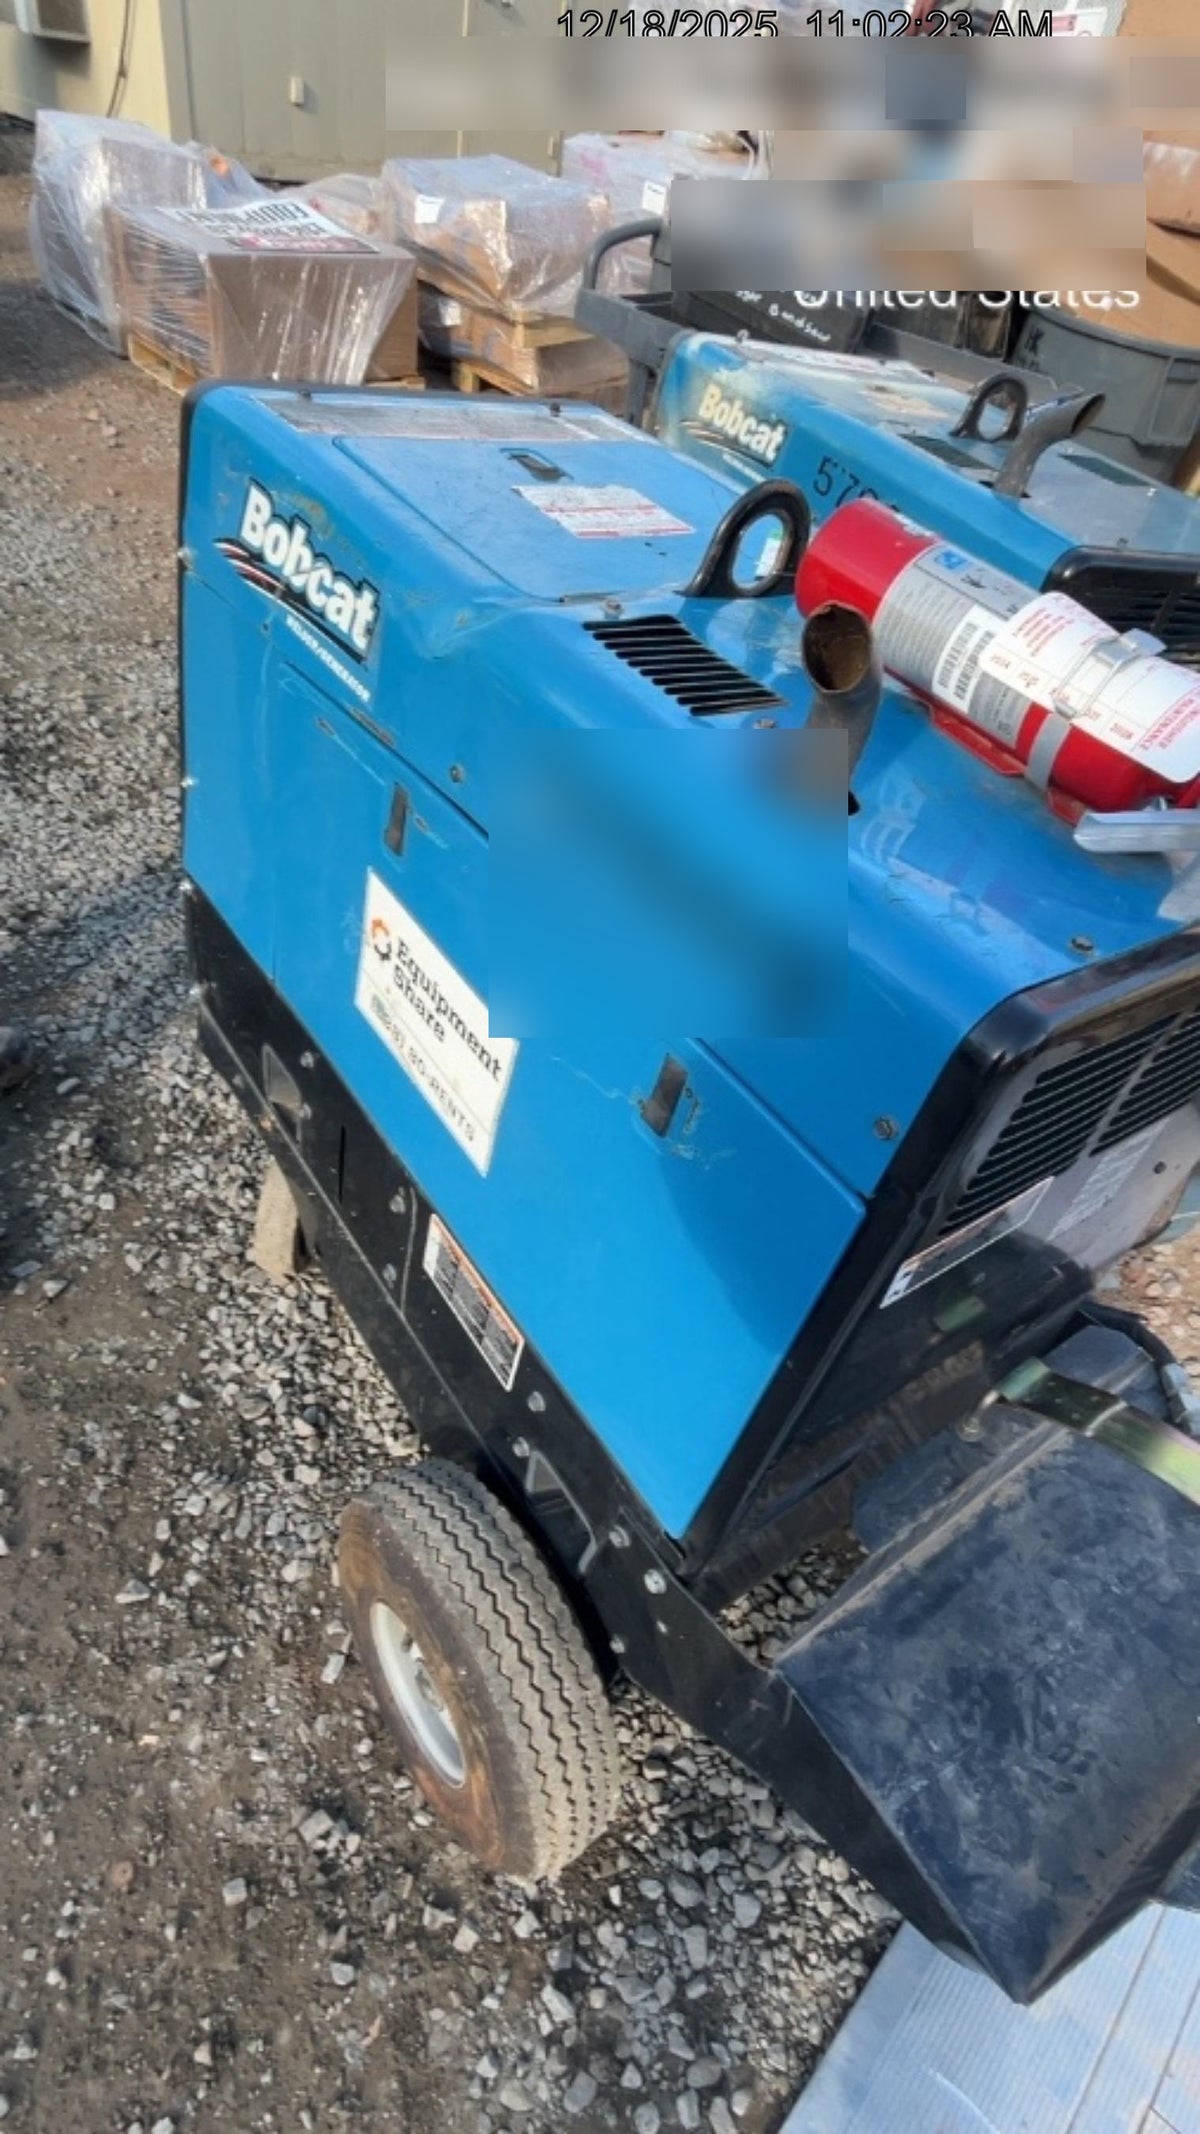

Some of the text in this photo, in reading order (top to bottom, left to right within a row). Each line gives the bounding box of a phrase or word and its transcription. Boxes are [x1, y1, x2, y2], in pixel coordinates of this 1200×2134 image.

[699, 383, 786, 463] Bobcat
[240, 480, 377, 652] Bobcat
[393, 963, 445, 1043] Share
[397, 936, 501, 1082] Equipment
